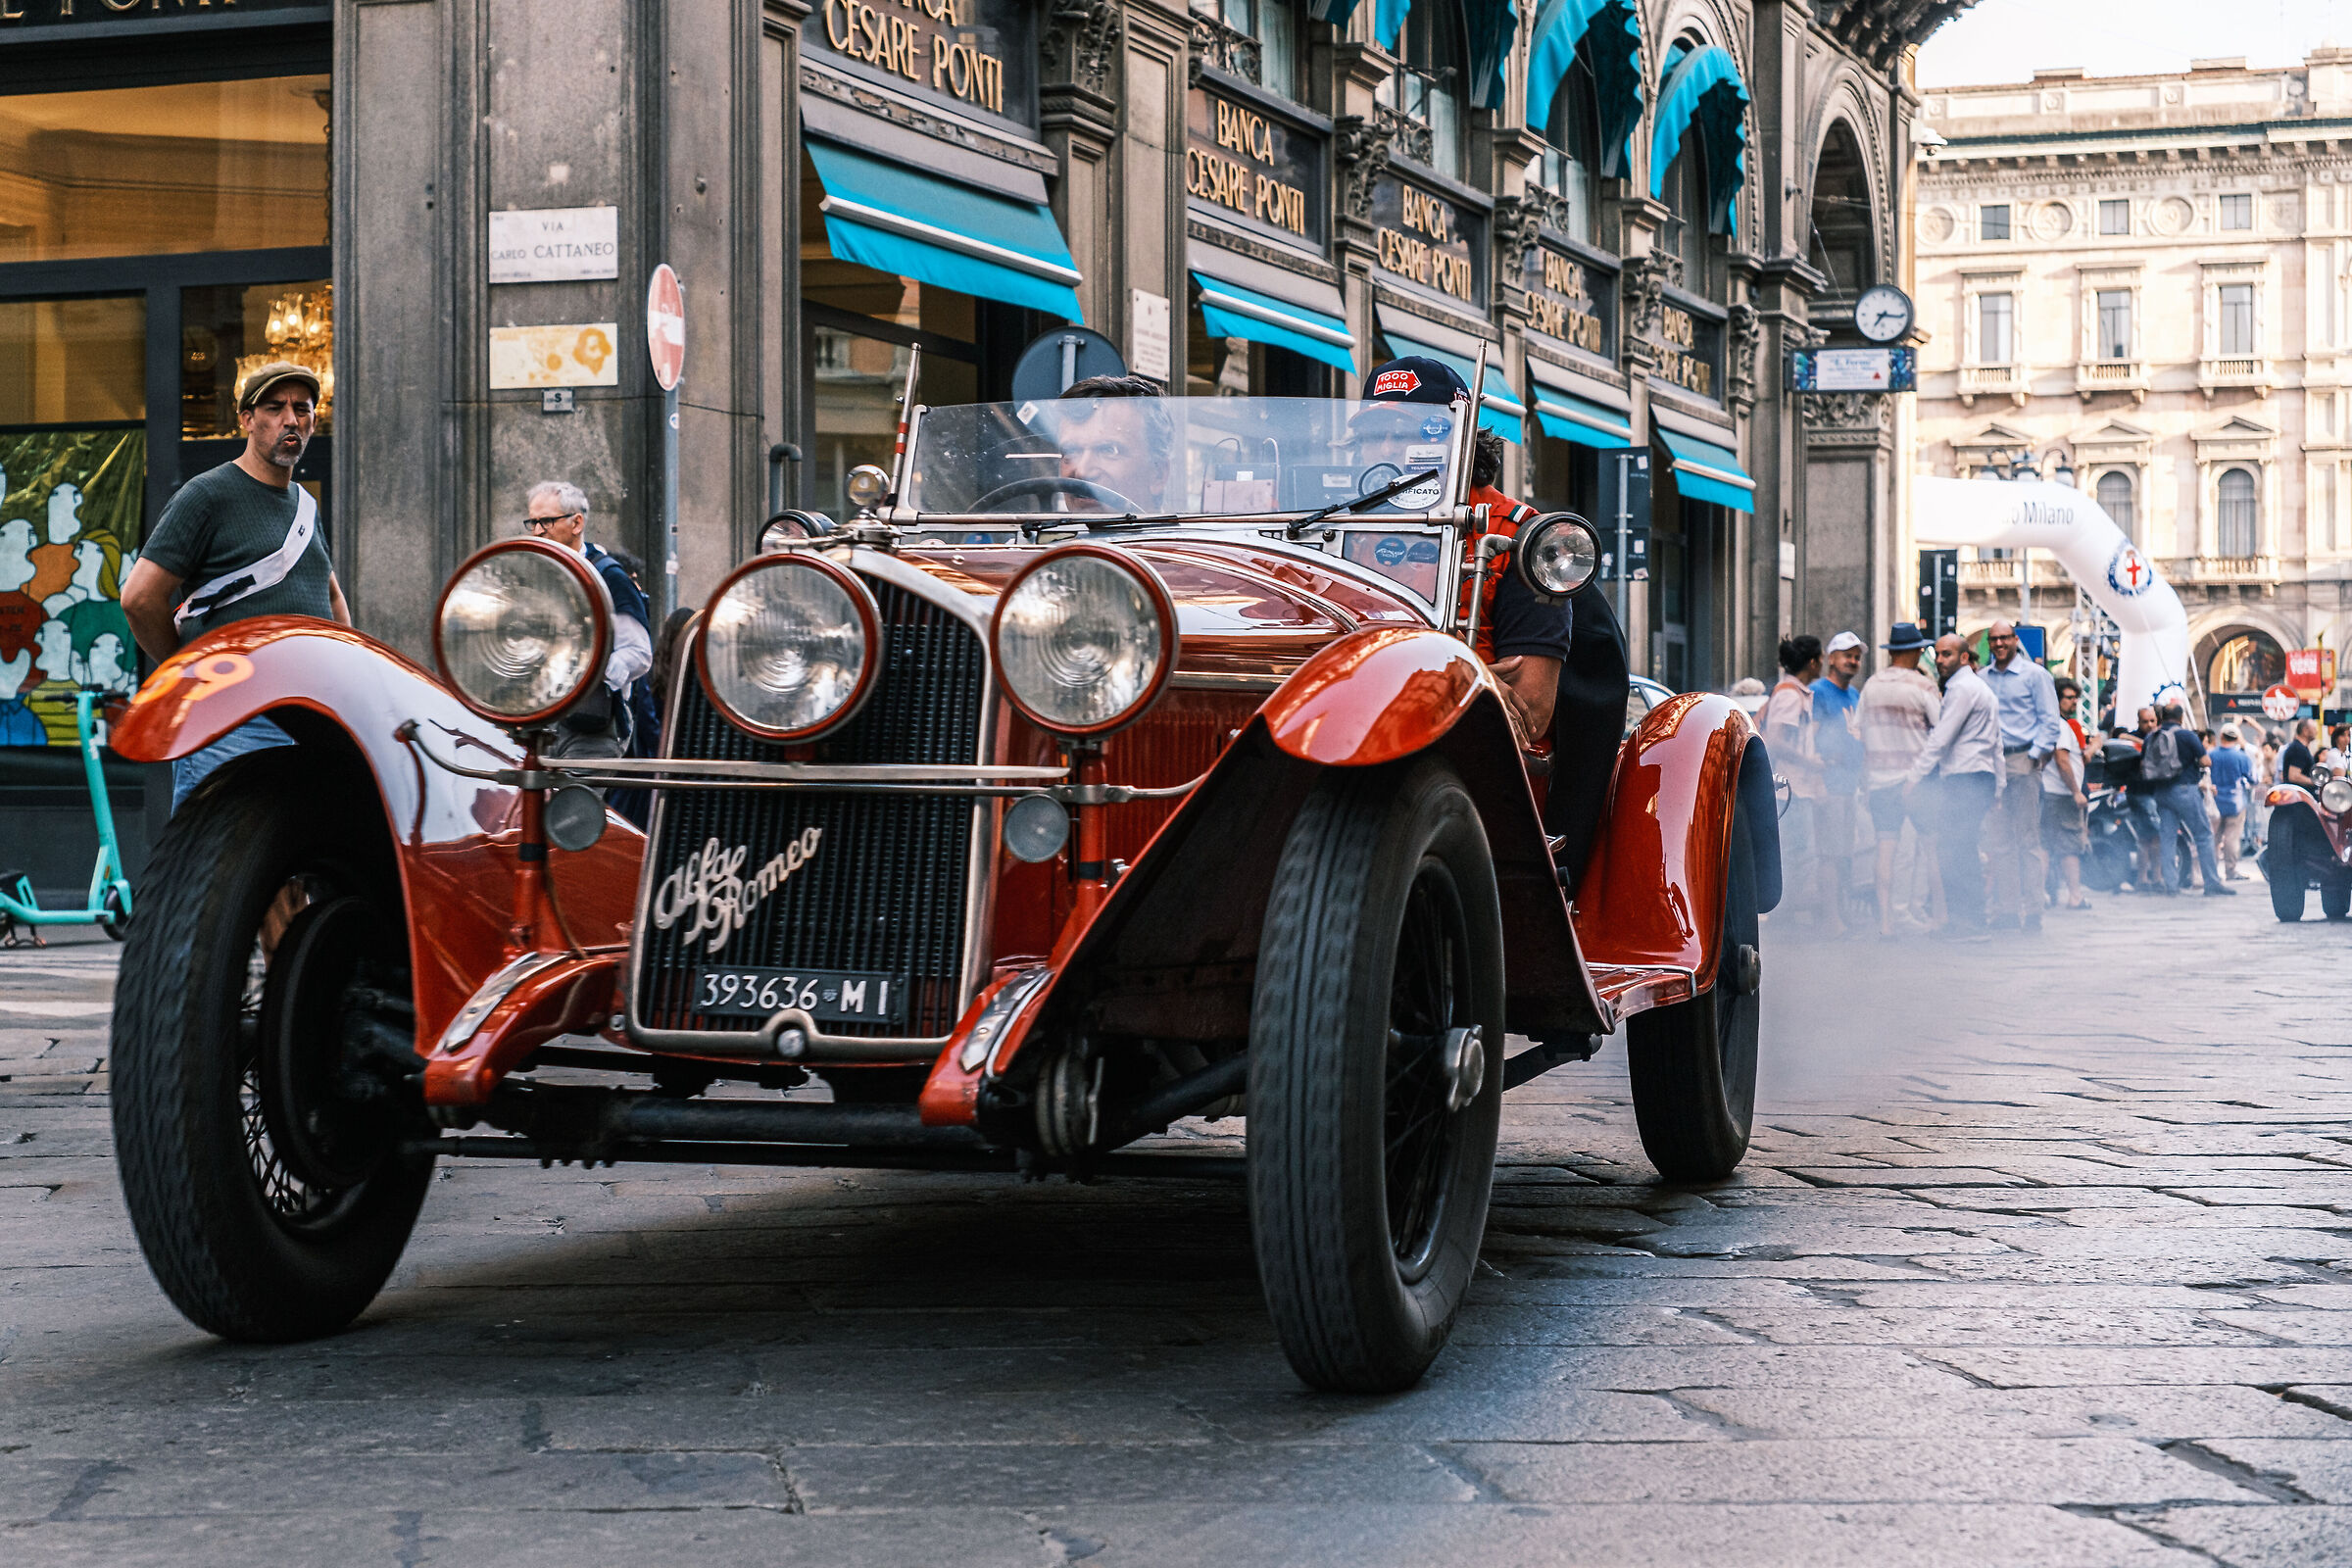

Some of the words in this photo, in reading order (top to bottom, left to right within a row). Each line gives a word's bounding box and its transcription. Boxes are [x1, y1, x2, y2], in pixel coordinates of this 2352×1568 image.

[824, 0, 921, 80] CESARE
[932, 33, 1003, 113] PONTI
[1217, 99, 1274, 167] BANCA
[1187, 147, 1249, 213] CESARE
[1255, 173, 1304, 235] PONTI
[1403, 184, 1447, 243] BANCA
[491, 249, 526, 260] CARLO
[534, 242, 614, 259] CATTANEO
[542, 221, 564, 231] VIA
[1378, 226, 1427, 284] CESARE
[1433, 248, 1471, 301] PONTI
[1545, 251, 1583, 301] BANCA
[1377, 381, 1409, 392] MIGLIA
[1380, 372, 1409, 383] 1000
[2024, 501, 2074, 525] Milano
[654, 837, 747, 946] Alfa
[702, 827, 823, 954] Romeo
[699, 973, 819, 1010] 393636
